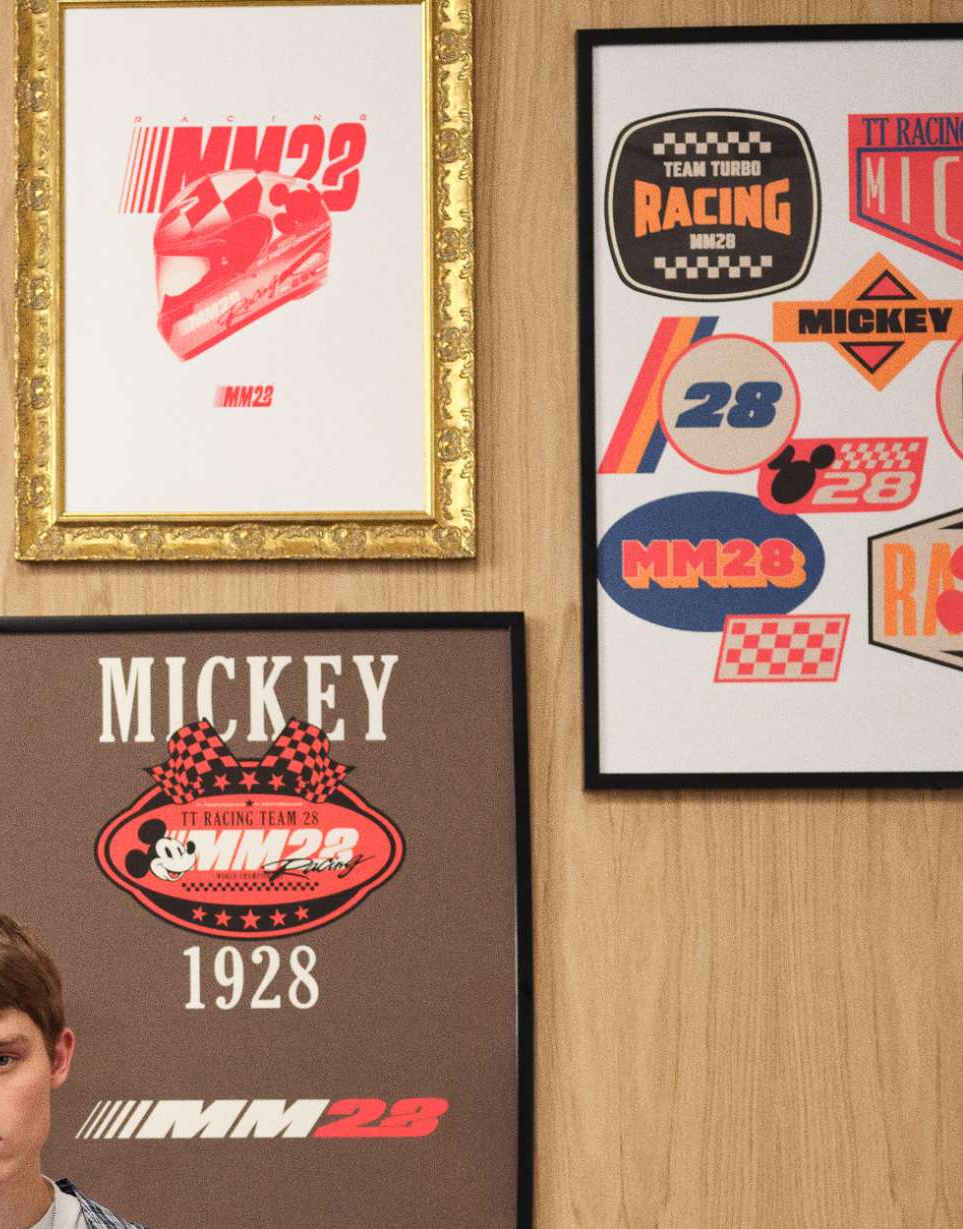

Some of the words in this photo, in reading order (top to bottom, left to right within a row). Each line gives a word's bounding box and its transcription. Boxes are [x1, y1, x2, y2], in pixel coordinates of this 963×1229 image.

[134, 114, 367, 123] RACING
[862, 117, 890, 146] TT
[896, 116, 963, 146] RACIN
[663, 161, 706, 178] TEAM
[710, 160, 761, 177] TURBO
[634, 178, 791, 238] RACING
[690, 233, 736, 250] MM28
[798, 307, 953, 334] MICKEY
[221, 385, 275, 408] MM28
[675, 381, 783, 428] 28
[811, 471, 916, 505] 28
[622, 539, 805, 589] MM28
[99, 655, 399, 743] MICKEY
[181, 812, 198, 827] TT
[204, 811, 253, 827] RACING
[260, 811, 297, 827] TEAM
[189, 828, 360, 872] MM28
[261, 855, 376, 882] Racing
[183, 945, 320, 1011] 1928
[135, 1096, 450, 1140] MM28
